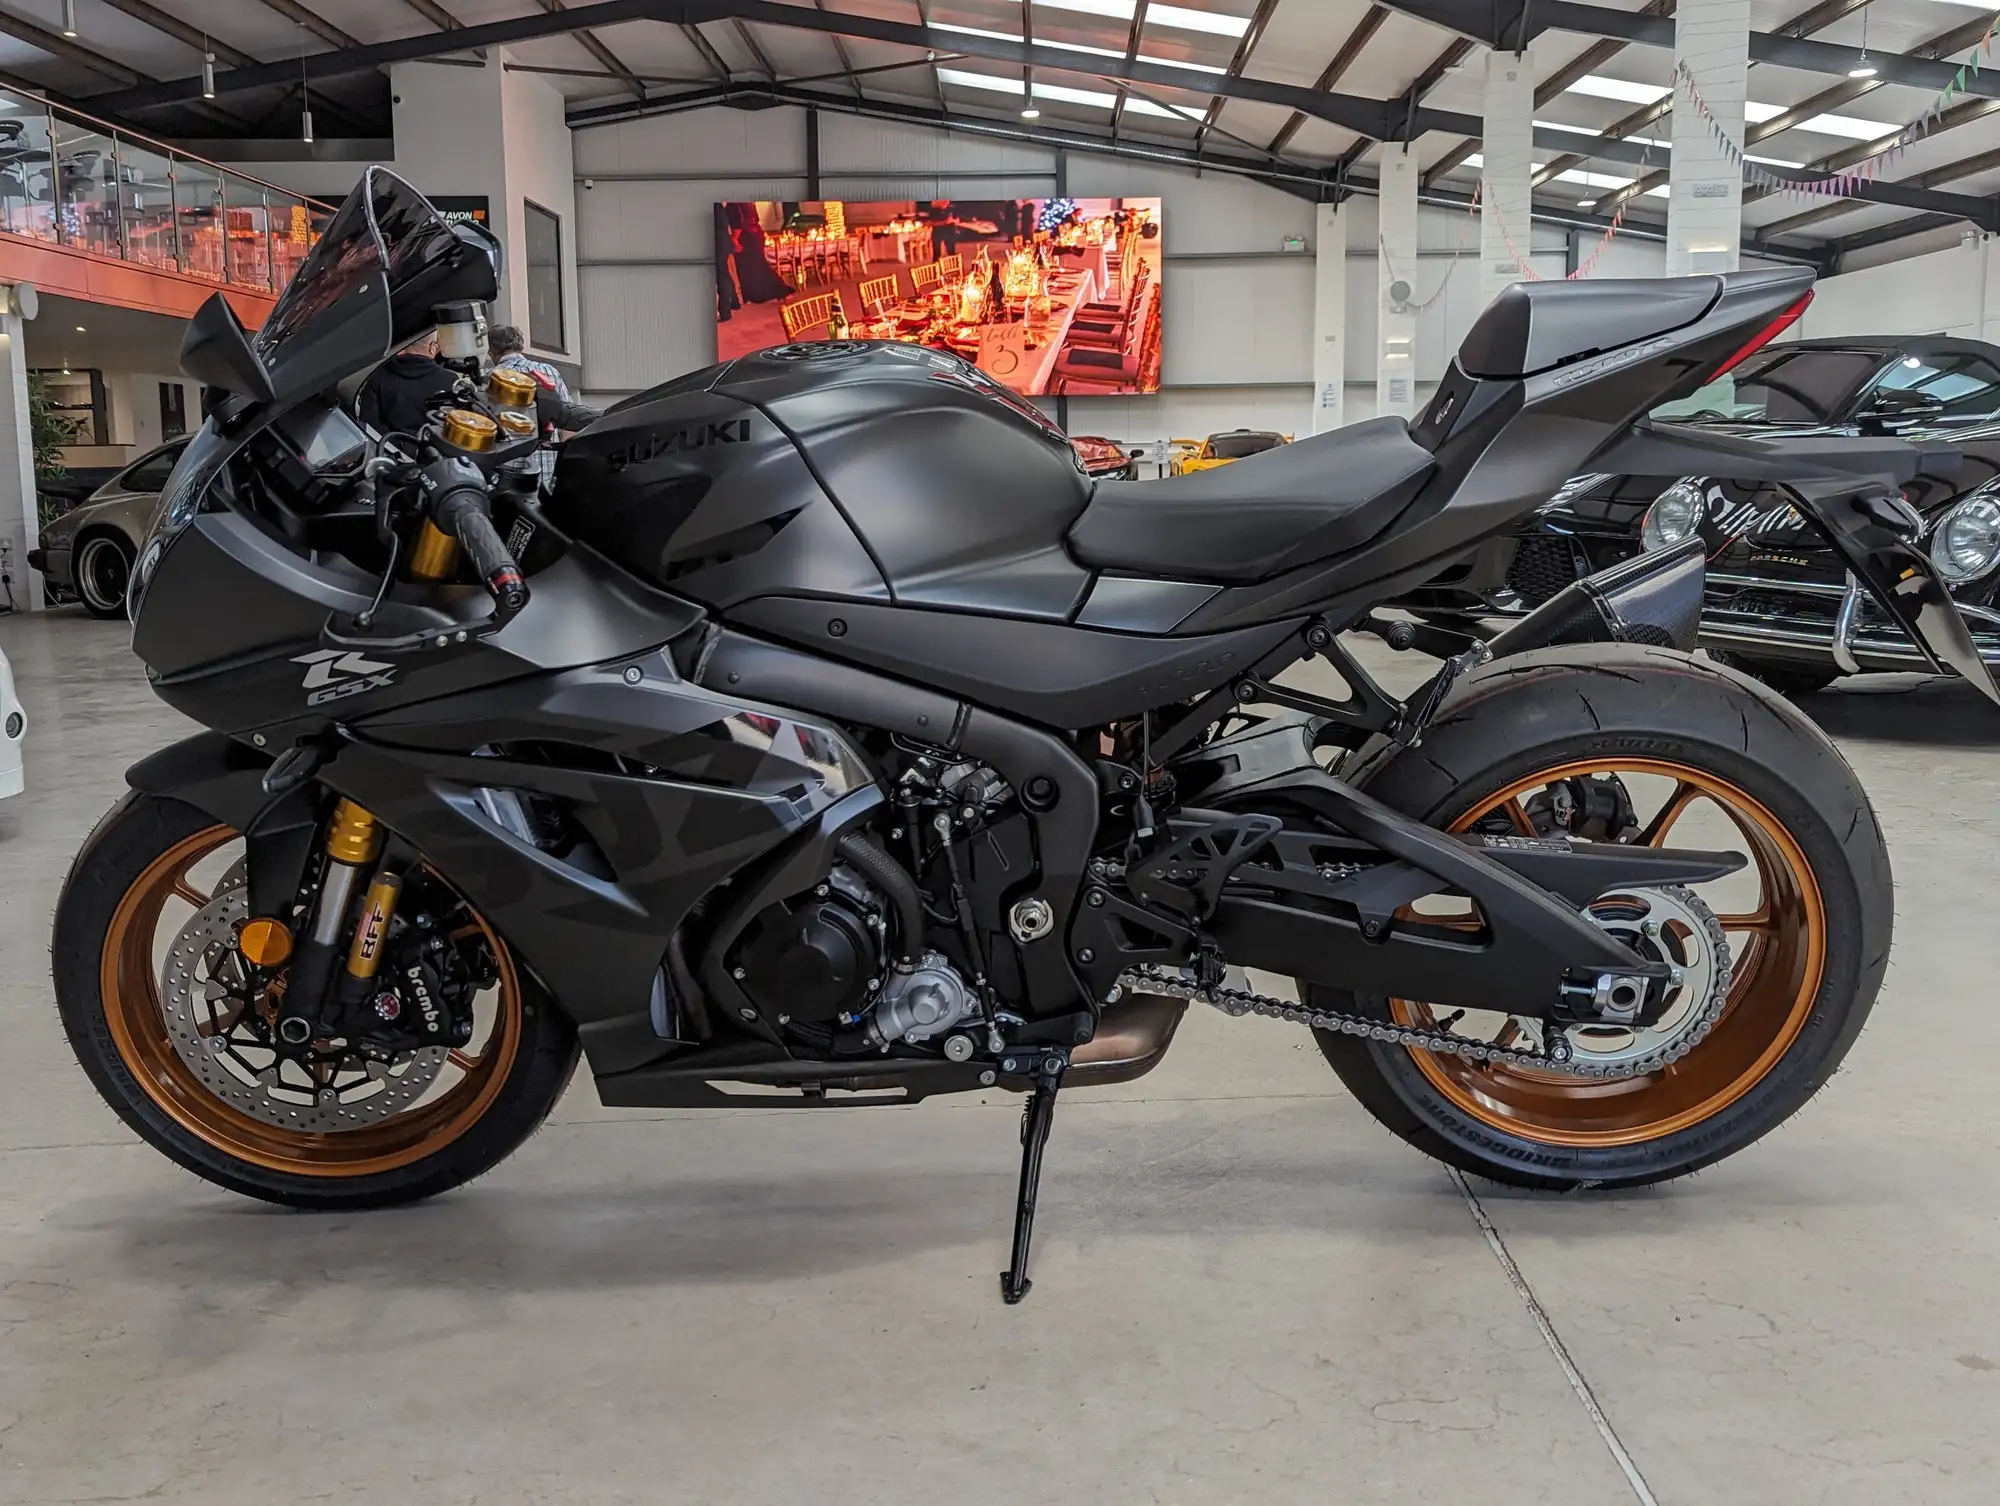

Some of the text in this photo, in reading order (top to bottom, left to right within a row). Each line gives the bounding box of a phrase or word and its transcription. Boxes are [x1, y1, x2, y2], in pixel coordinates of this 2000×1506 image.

[446, 211, 472, 220] AVON
[991, 344, 1019, 375] 3
[606, 419, 750, 473] SUZUKI
[307, 669, 398, 706] GSX
[359, 901, 385, 960] BFF
[408, 966, 439, 1032] brembo
